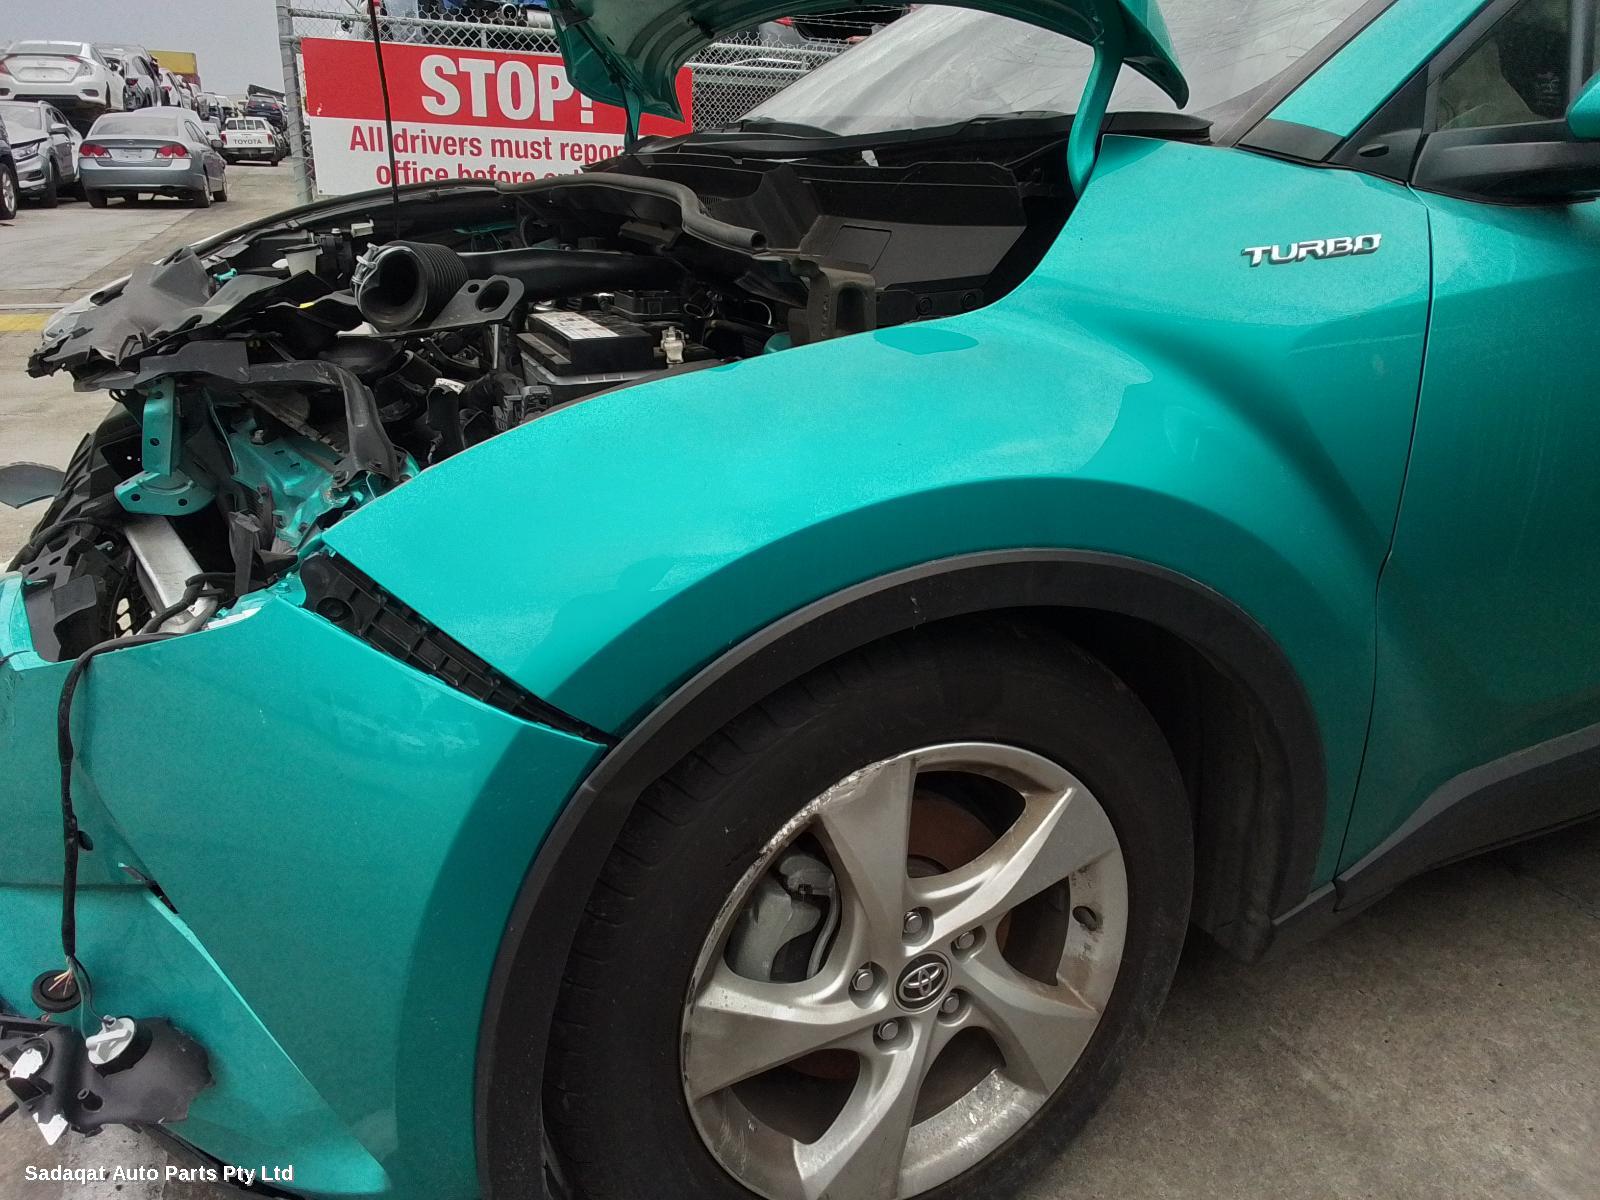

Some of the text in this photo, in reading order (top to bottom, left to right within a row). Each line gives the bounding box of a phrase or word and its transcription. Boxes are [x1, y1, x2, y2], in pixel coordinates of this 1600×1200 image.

[350, 125, 625, 165] All drivers must repor
[376, 160, 449, 185] office
[1241, 233, 1382, 267] TURBO
